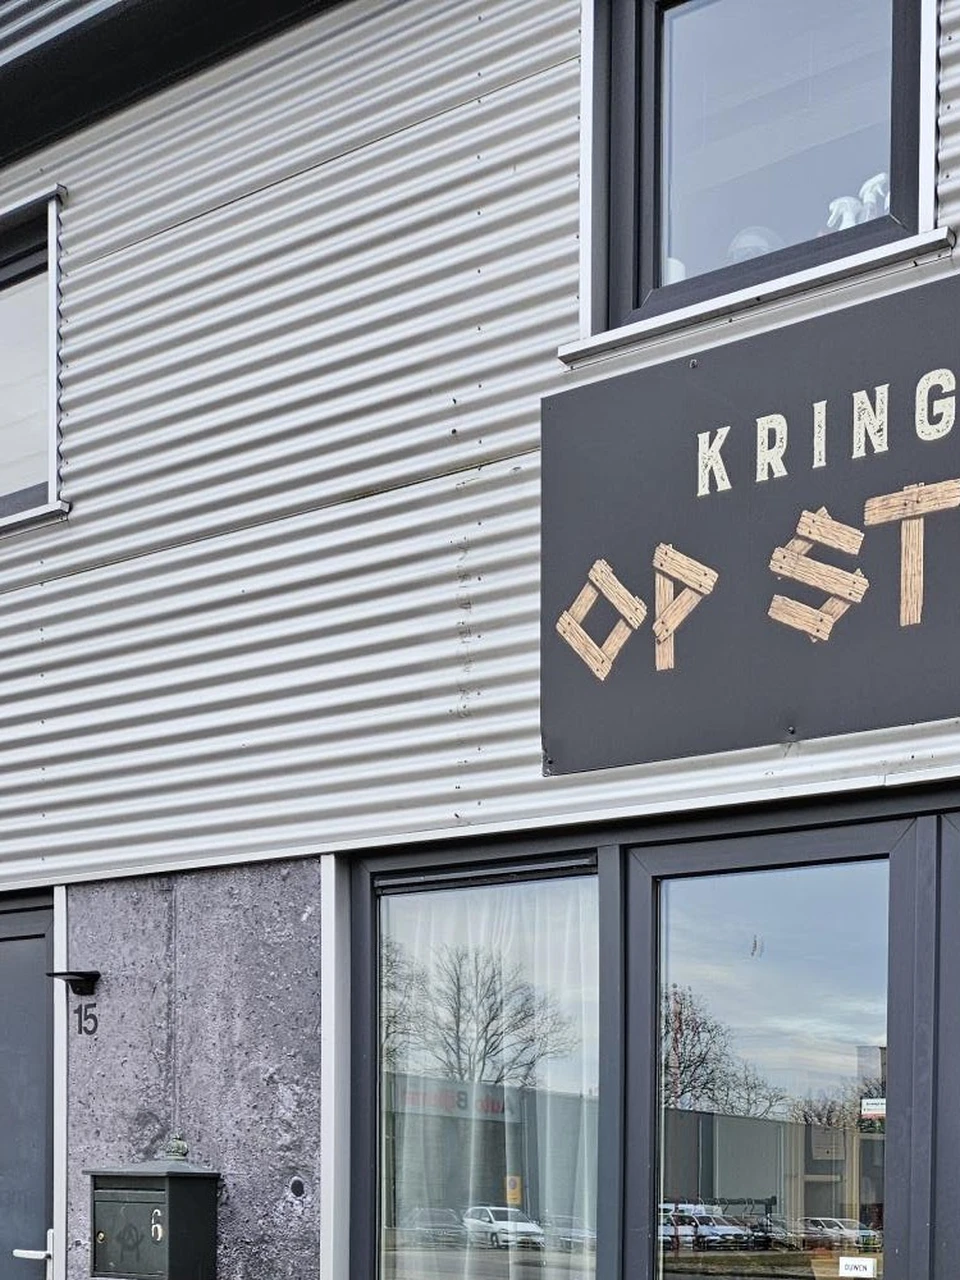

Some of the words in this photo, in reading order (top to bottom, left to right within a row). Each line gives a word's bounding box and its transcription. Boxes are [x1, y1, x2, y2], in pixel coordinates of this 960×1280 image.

[555, 542, 719, 681] OP
[73, 1003, 99, 1035] 15
[150, 1208, 163, 1242] 6
